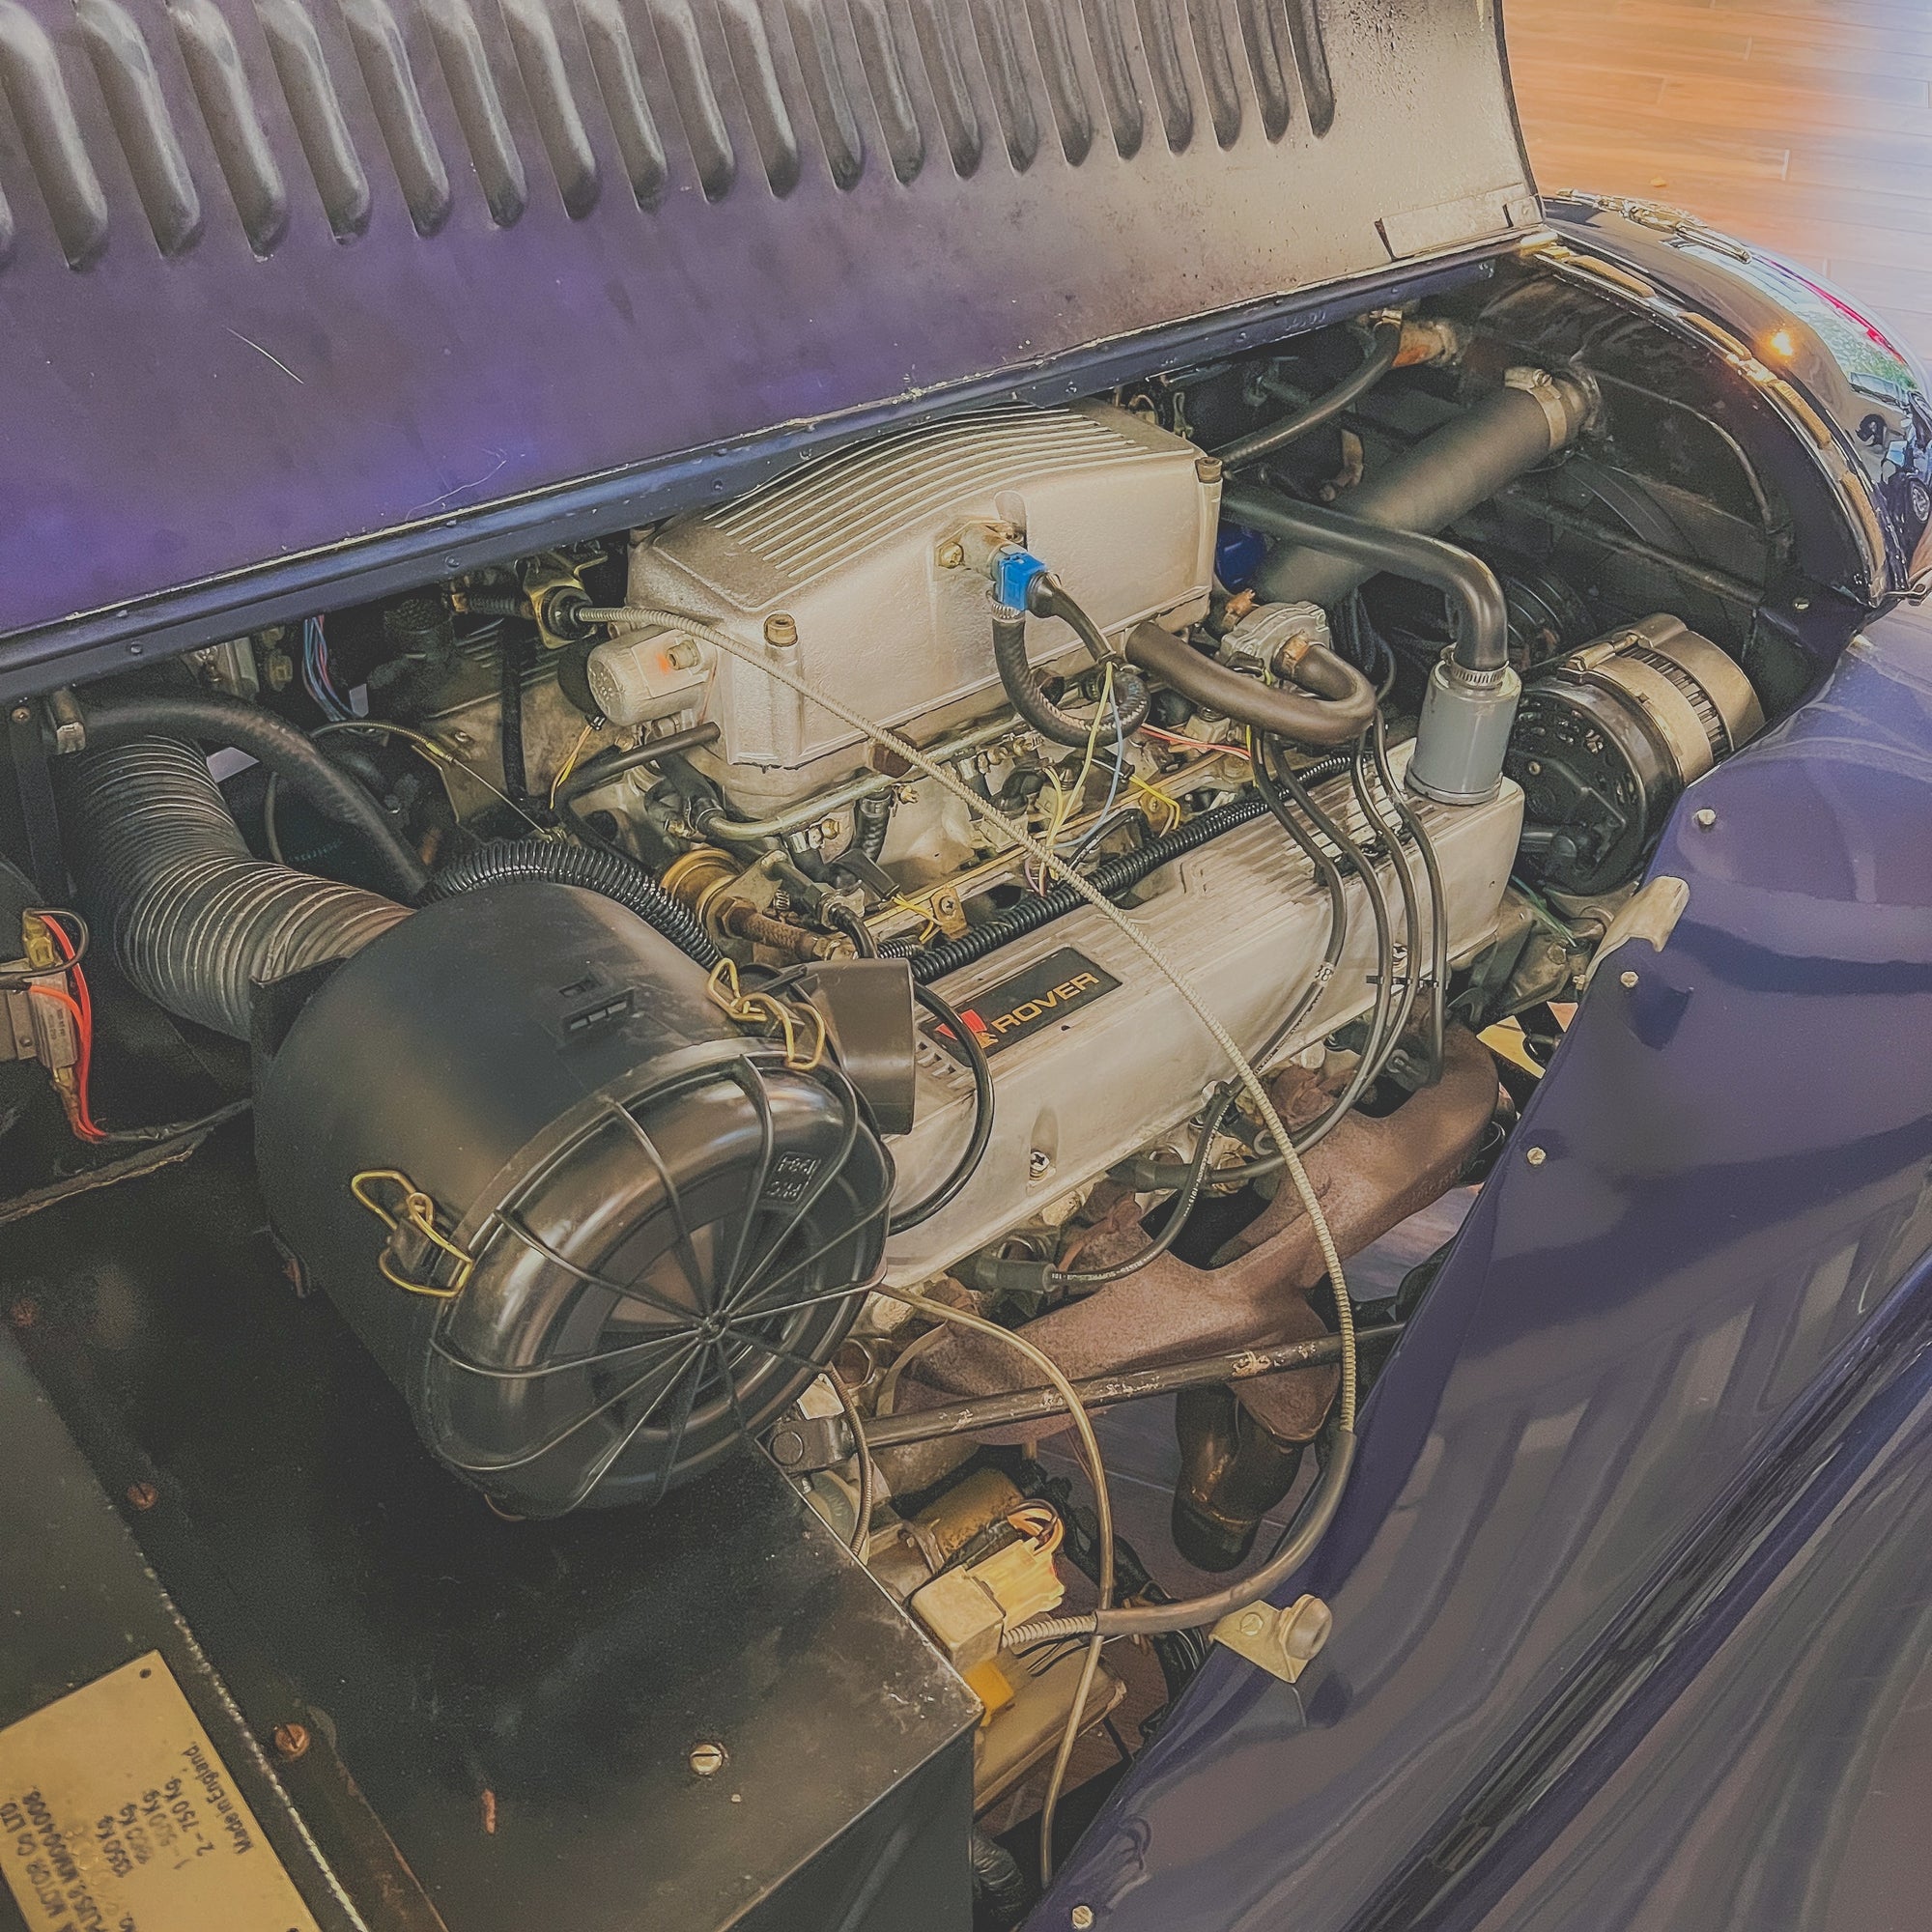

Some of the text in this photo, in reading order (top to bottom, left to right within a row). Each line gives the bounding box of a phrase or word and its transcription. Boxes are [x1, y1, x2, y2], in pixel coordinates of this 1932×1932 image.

[991, 972, 1100, 1034] ROVER
[172, 1801, 199, 1832] 750
[215, 1798, 233, 1818] in
[196, 1841, 214, 1856] 2
[224, 1812, 254, 1855] Made
